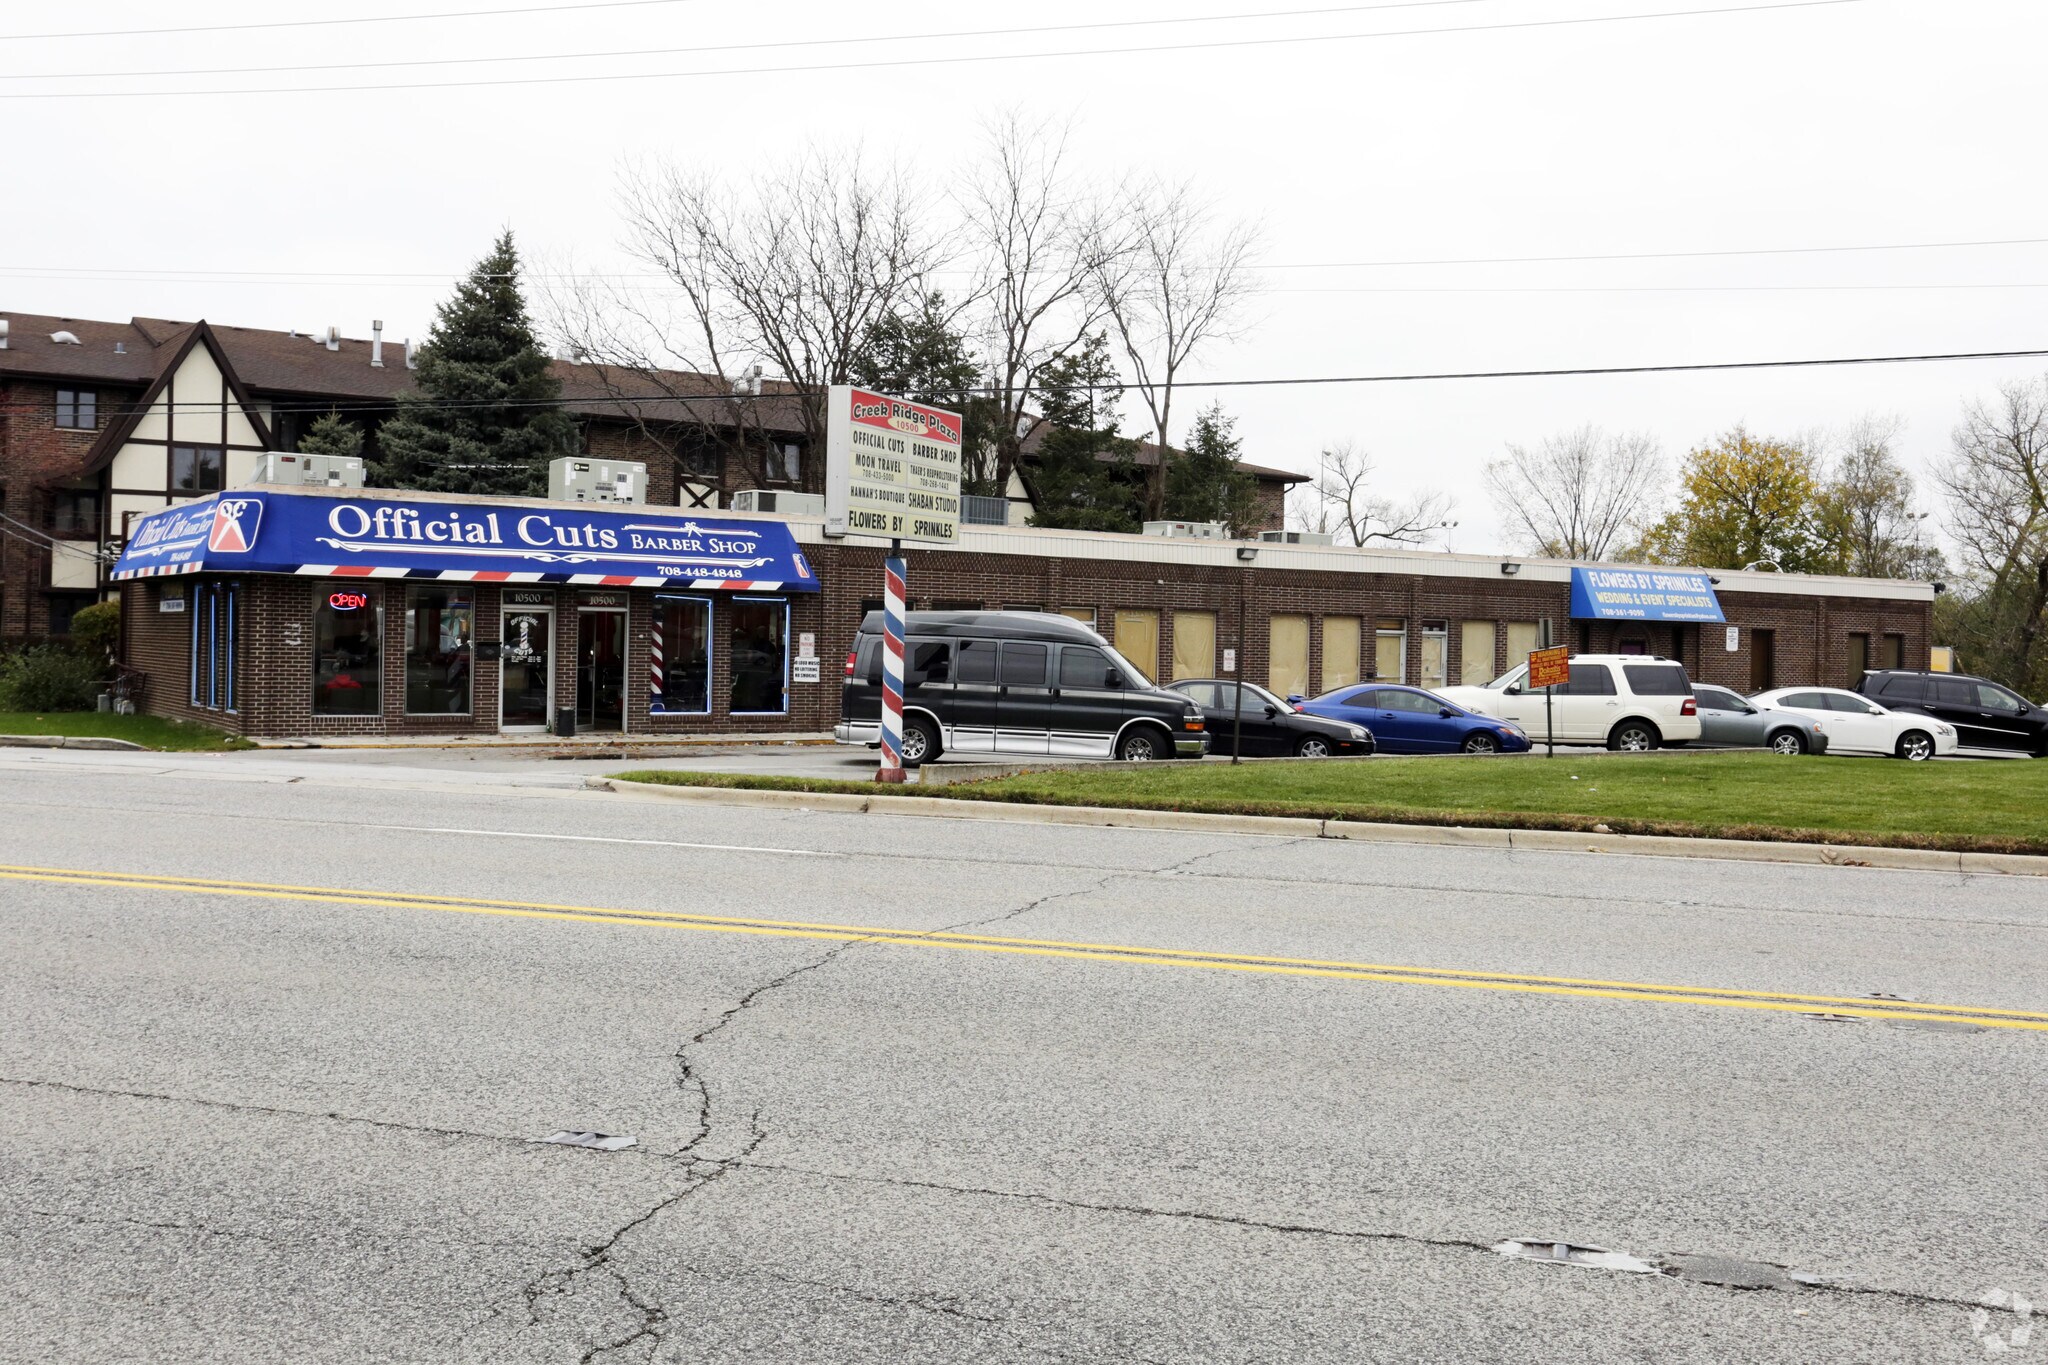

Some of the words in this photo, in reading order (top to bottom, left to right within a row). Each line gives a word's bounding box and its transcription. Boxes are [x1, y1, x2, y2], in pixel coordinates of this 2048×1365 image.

[853, 402, 888, 419] Creek
[892, 403, 926, 424] Ridge
[928, 414, 958, 442] Plaza
[896, 420, 919, 433] 10500
[853, 430, 885, 450] OFFICIAL
[888, 438, 904, 454] CUTS
[912, 443, 938, 460] BARBER
[940, 449, 957, 463] SHOP
[855, 453, 876, 469] MOON
[878, 458, 901, 473] TRAVEL
[850, 486, 878, 499] HANNAH'S
[879, 489, 905, 504] BOUTIQUE
[908, 492, 934, 511] SHABAN
[935, 496, 957, 513] STUDIO
[328, 504, 503, 544] Official
[517, 515, 618, 549] Cuts
[848, 510, 887, 530] FLOWERS
[892, 516, 903, 532] BY
[914, 519, 953, 538] SPRINKLES
[657, 566, 743, 578] 708-448-4848
[1588, 571, 1638, 589] FLOWERS
[1636, 573, 1652, 590] BY
[1652, 574, 1707, 593] SPRINKLES
[329, 593, 366, 608] OPEN
[514, 593, 541, 603] 10500
[589, 595, 615, 605] 10500
[1595, 591, 1633, 605] WEDDING
[1634, 593, 1640, 605] &
[1640, 593, 1666, 606] EVENT
[1666, 594, 1713, 608] SPECIALISTS
[510, 615, 539, 626] OFFICIAL
[513, 647, 534, 656] CUTS
